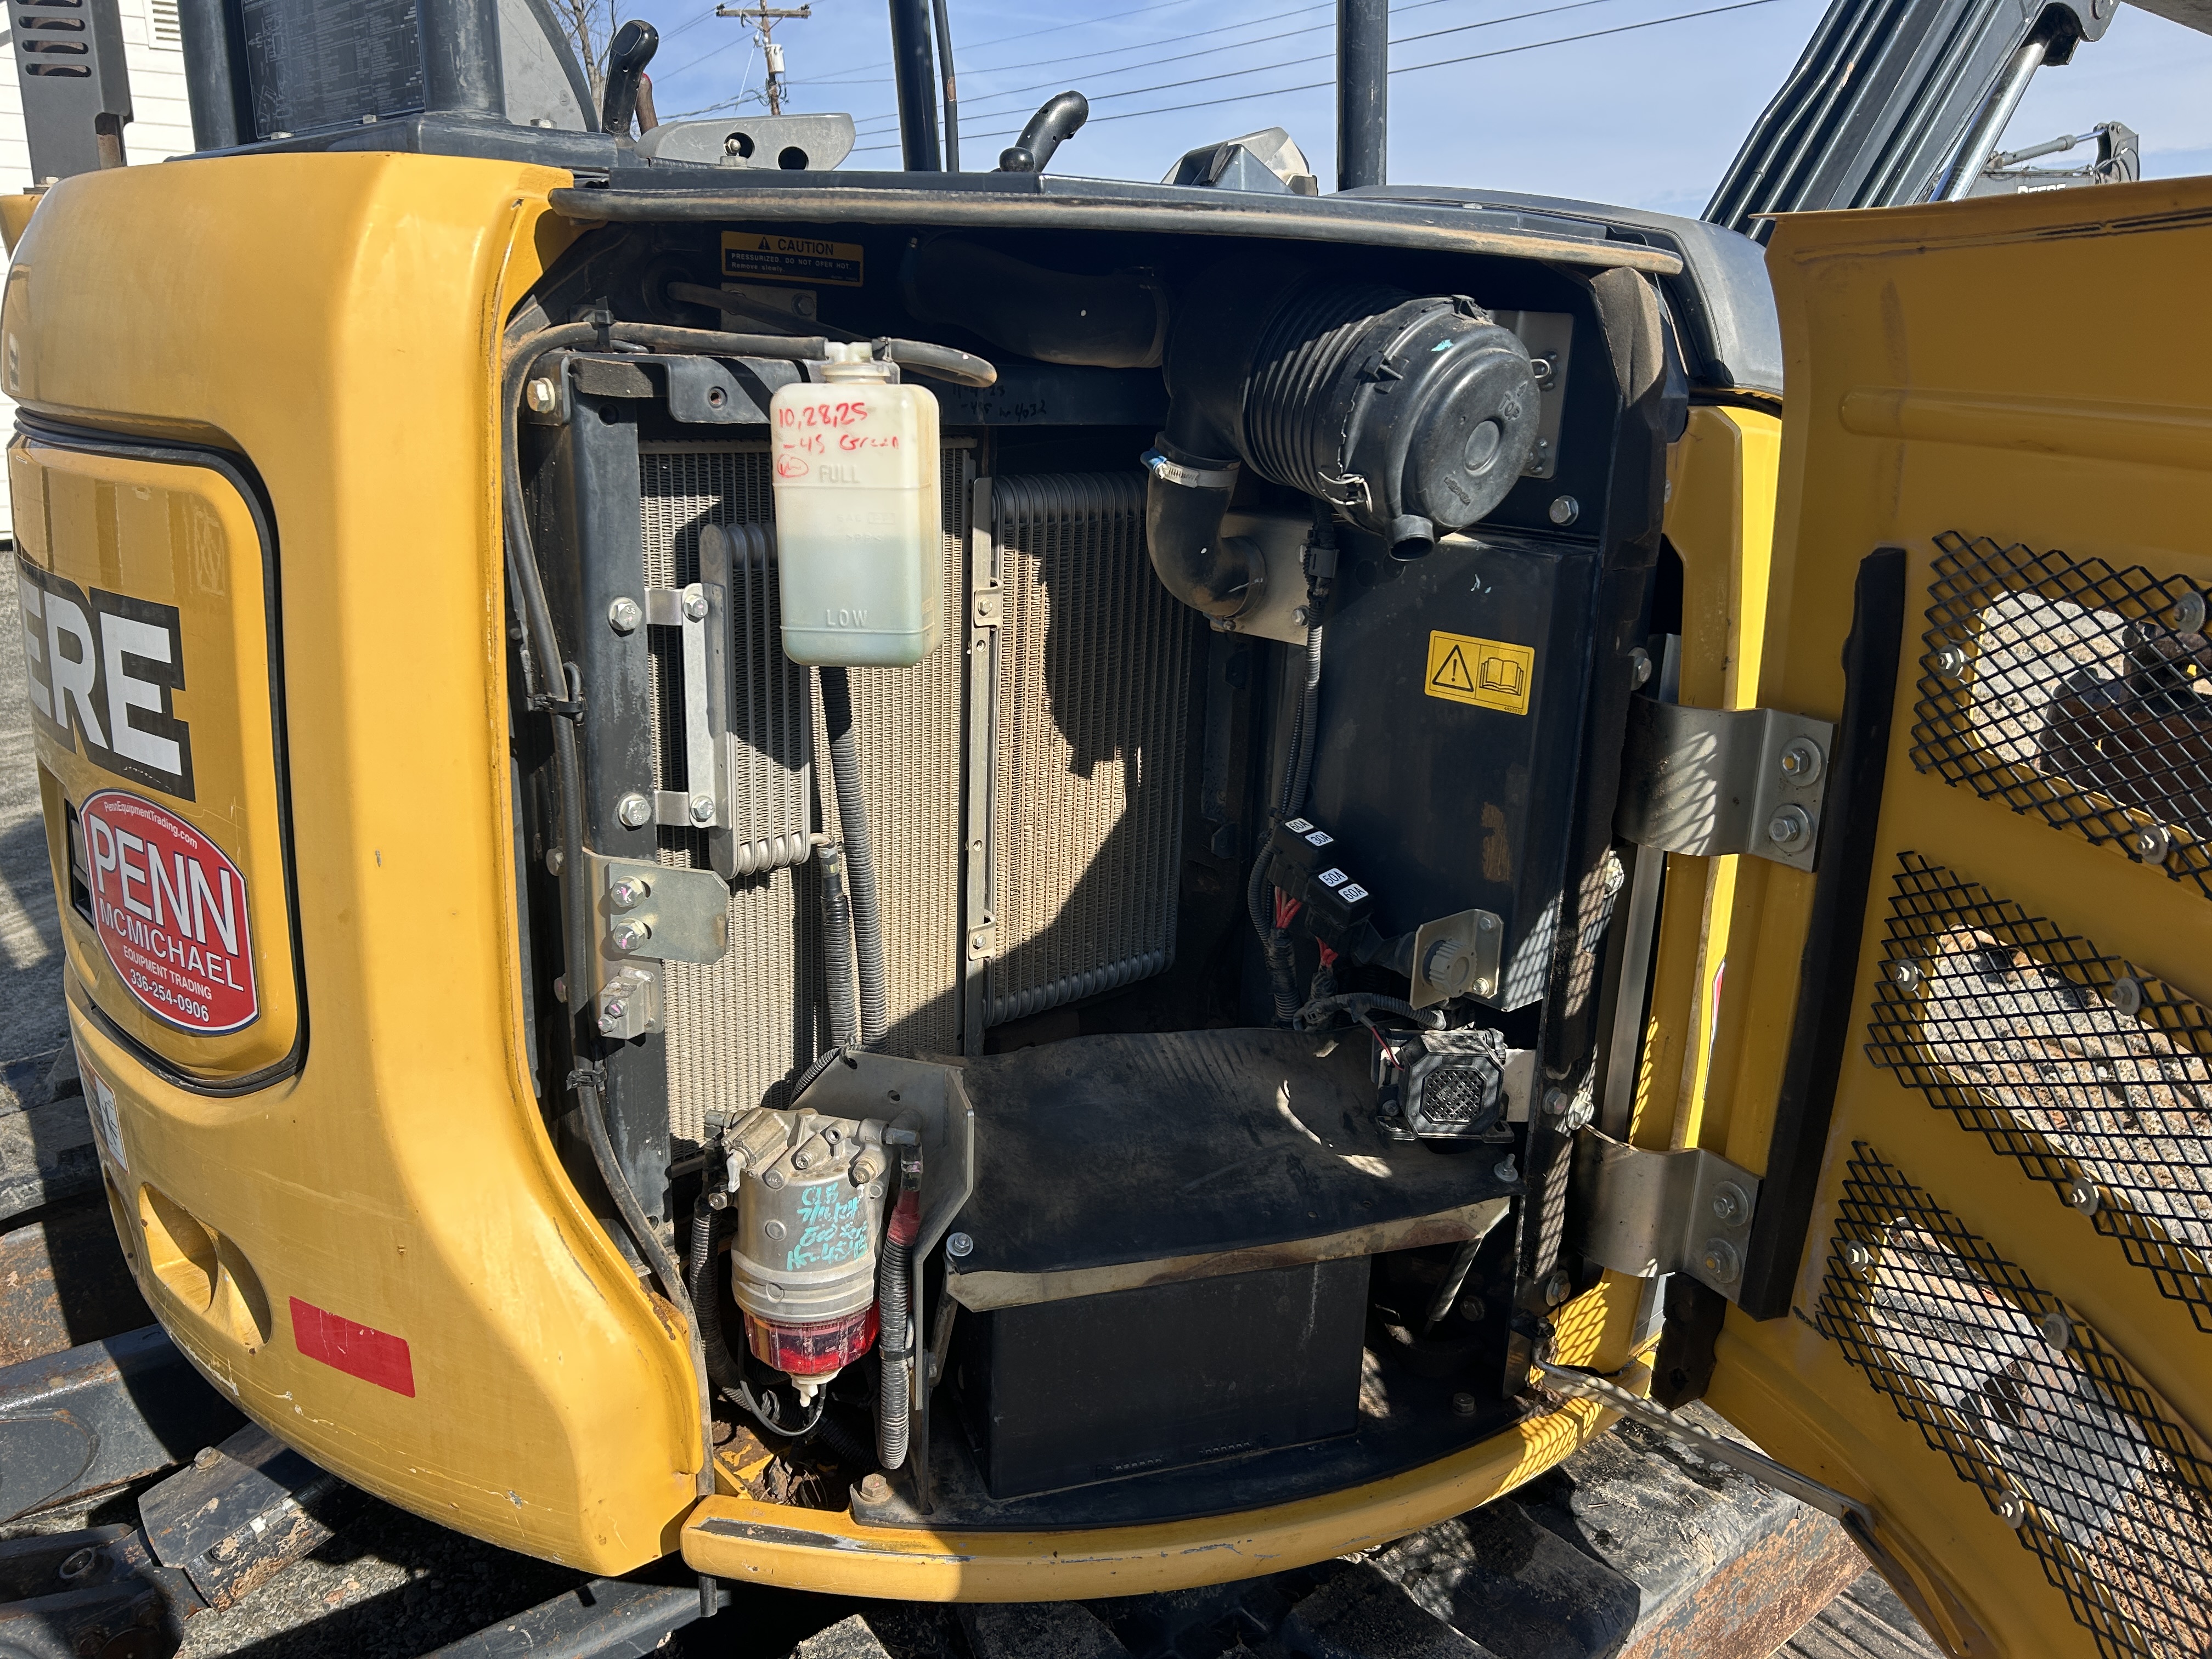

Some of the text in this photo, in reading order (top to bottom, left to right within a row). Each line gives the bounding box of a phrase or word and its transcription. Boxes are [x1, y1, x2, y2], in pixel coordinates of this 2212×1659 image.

[777, 238, 834, 256] CAUTION
[731, 262, 758, 270] Remove
[815, 260, 833, 268] OPEN
[1499, 391, 1520, 420] TOP
[819, 465, 860, 484] FULL
[826, 608, 868, 627] LOW
[104, 800, 198, 850] PennEquipmentTrading.com
[1289, 820, 1311, 831] 60A
[1310, 833, 1331, 844] 30A
[89, 814, 239, 957] PENN
[1322, 870, 1346, 884] 50A
[1342, 886, 1365, 900] 60A
[99, 895, 245, 991] MCMICHAEL
[123, 945, 212, 1000] EQUIPMENT TRADING
[130, 968, 210, 1022] 336-254-0906
